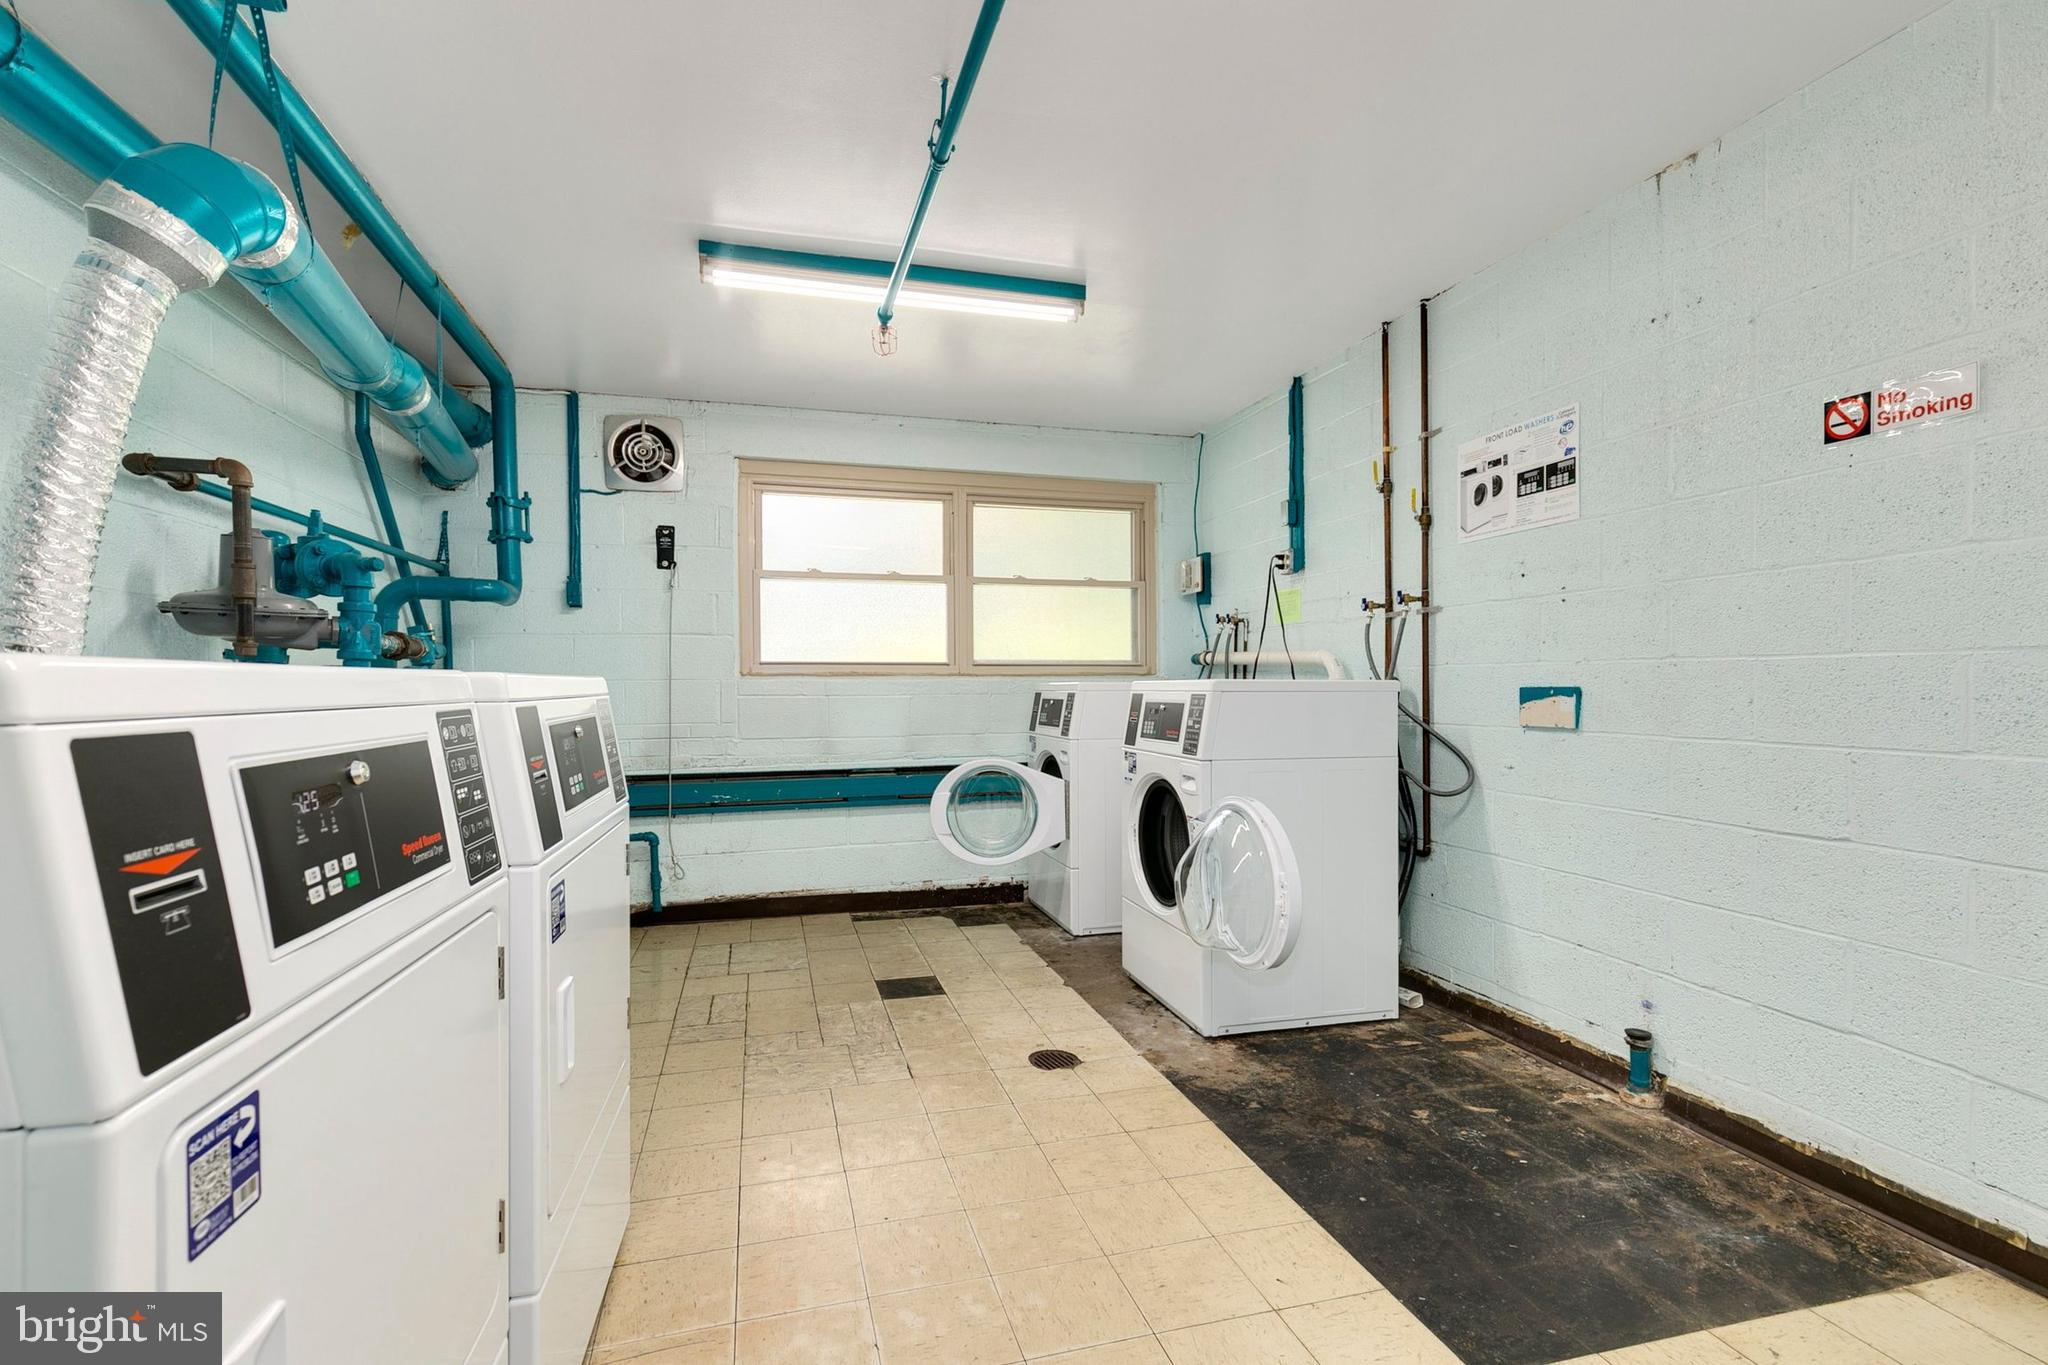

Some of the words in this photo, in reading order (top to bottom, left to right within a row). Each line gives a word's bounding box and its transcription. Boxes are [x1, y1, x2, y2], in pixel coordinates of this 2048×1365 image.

[1877, 391, 1907, 408] No
[1877, 392, 1973, 426] Smoking
[1485, 431, 1505, 445] FRONT
[1504, 424, 1523, 438] LOAD
[1523, 414, 1554, 431] WASHERS
[123, 847, 154, 864] INSERT
[153, 842, 175, 856] CARD
[175, 837, 196, 850] HERE
[402, 837, 423, 857] Speed
[422, 832, 442, 847] Queen
[412, 850, 434, 865] Commercial
[189, 1128, 215, 1157] SCAN
[216, 1110, 241, 1138] HERE
